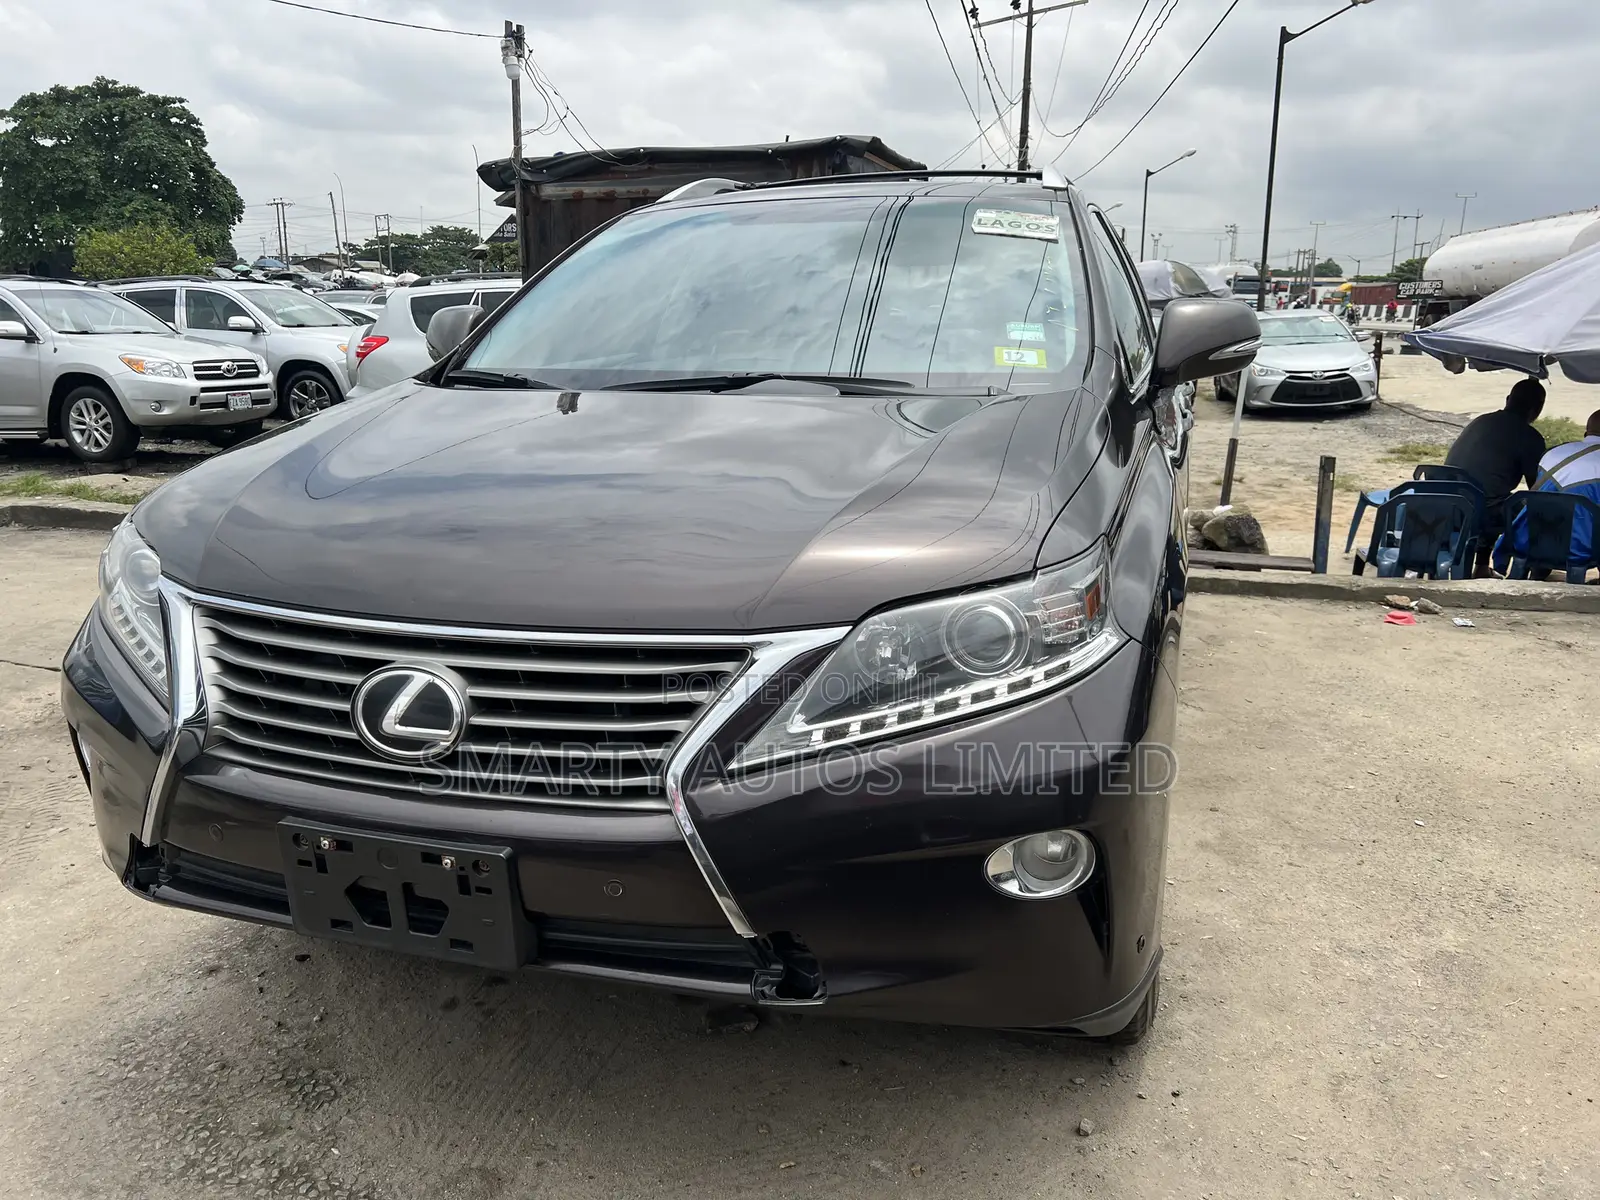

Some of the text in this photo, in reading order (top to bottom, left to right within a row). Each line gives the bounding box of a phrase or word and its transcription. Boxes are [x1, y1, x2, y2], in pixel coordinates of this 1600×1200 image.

[977, 218, 1056, 232] LAGOS
[1399, 281, 1442, 290] CUSTOMERS
[1004, 350, 1026, 362] 12
